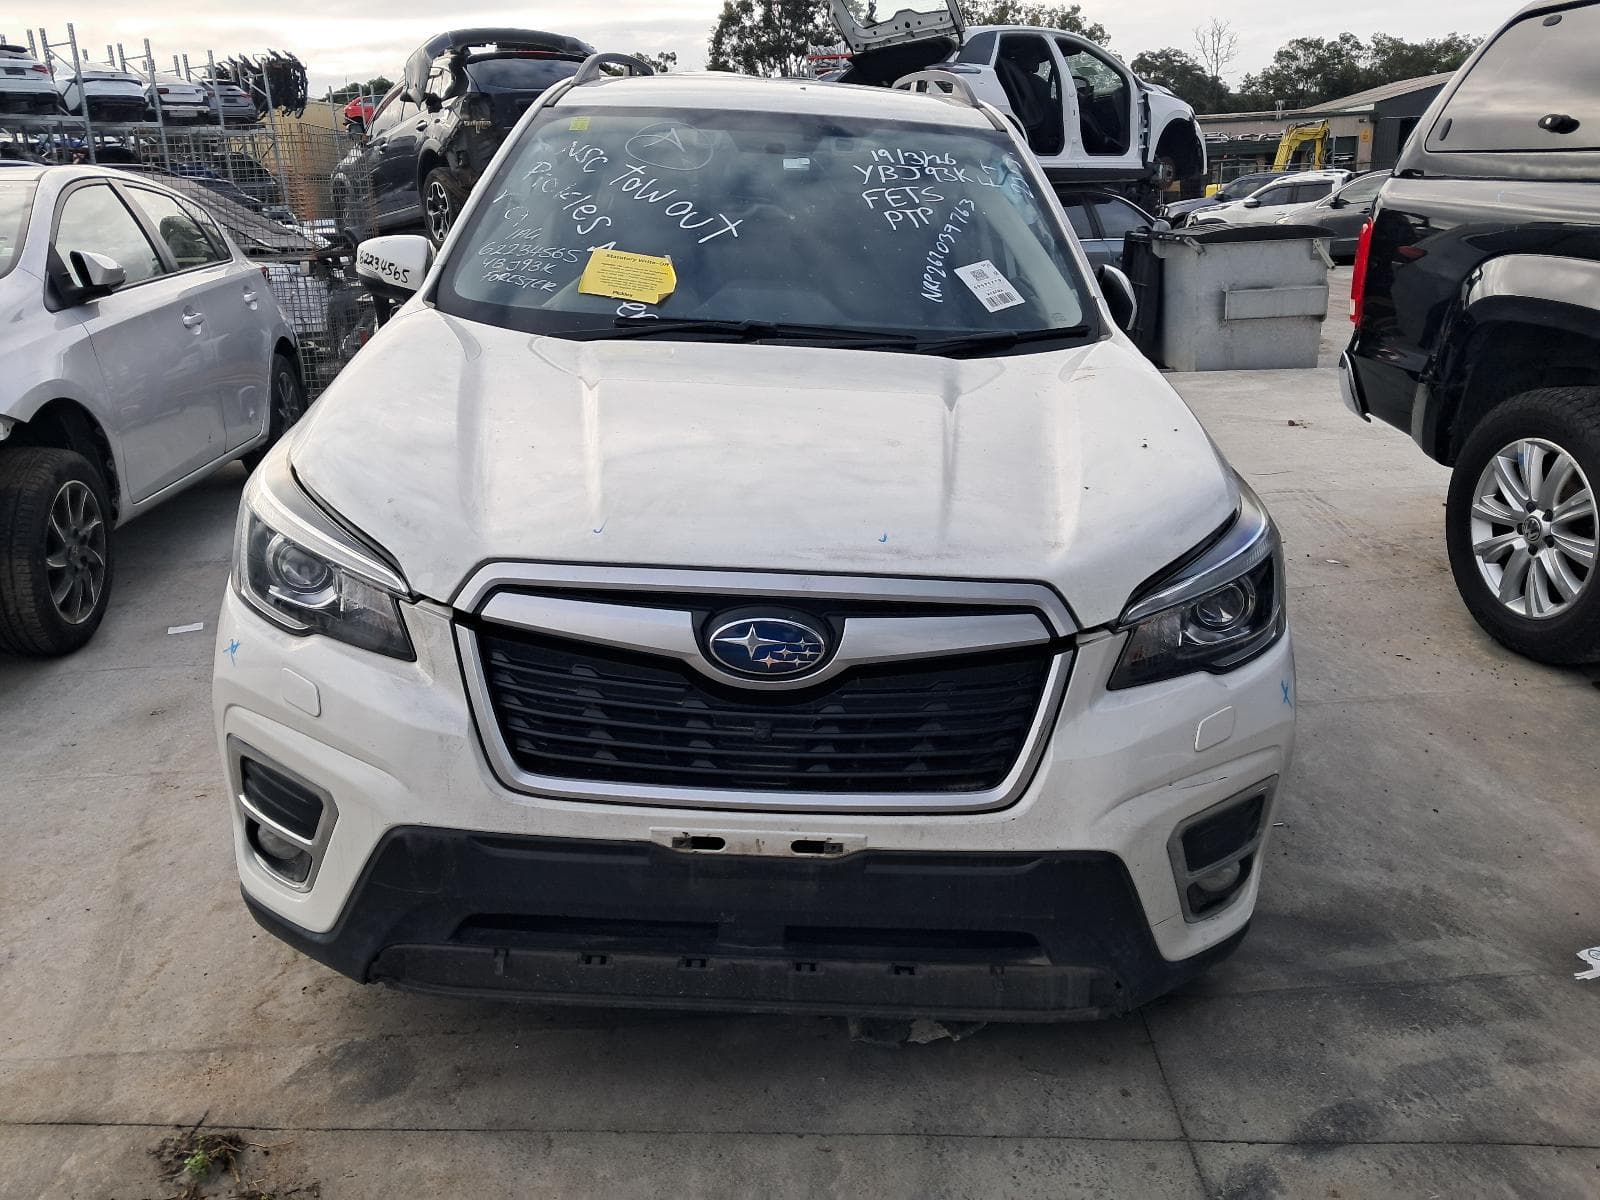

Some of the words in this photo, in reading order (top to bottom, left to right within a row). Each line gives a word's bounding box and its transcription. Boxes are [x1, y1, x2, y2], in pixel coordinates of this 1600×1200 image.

[853, 165, 975, 184] YBJ93K
[861, 186, 946, 209] FETS
[883, 207, 934, 230] PTP
[478, 241, 582, 263] 62234565
[606, 253, 638, 263] Statutory
[359, 250, 411, 284] 62234565
[480, 271, 558, 292] FORESTER
